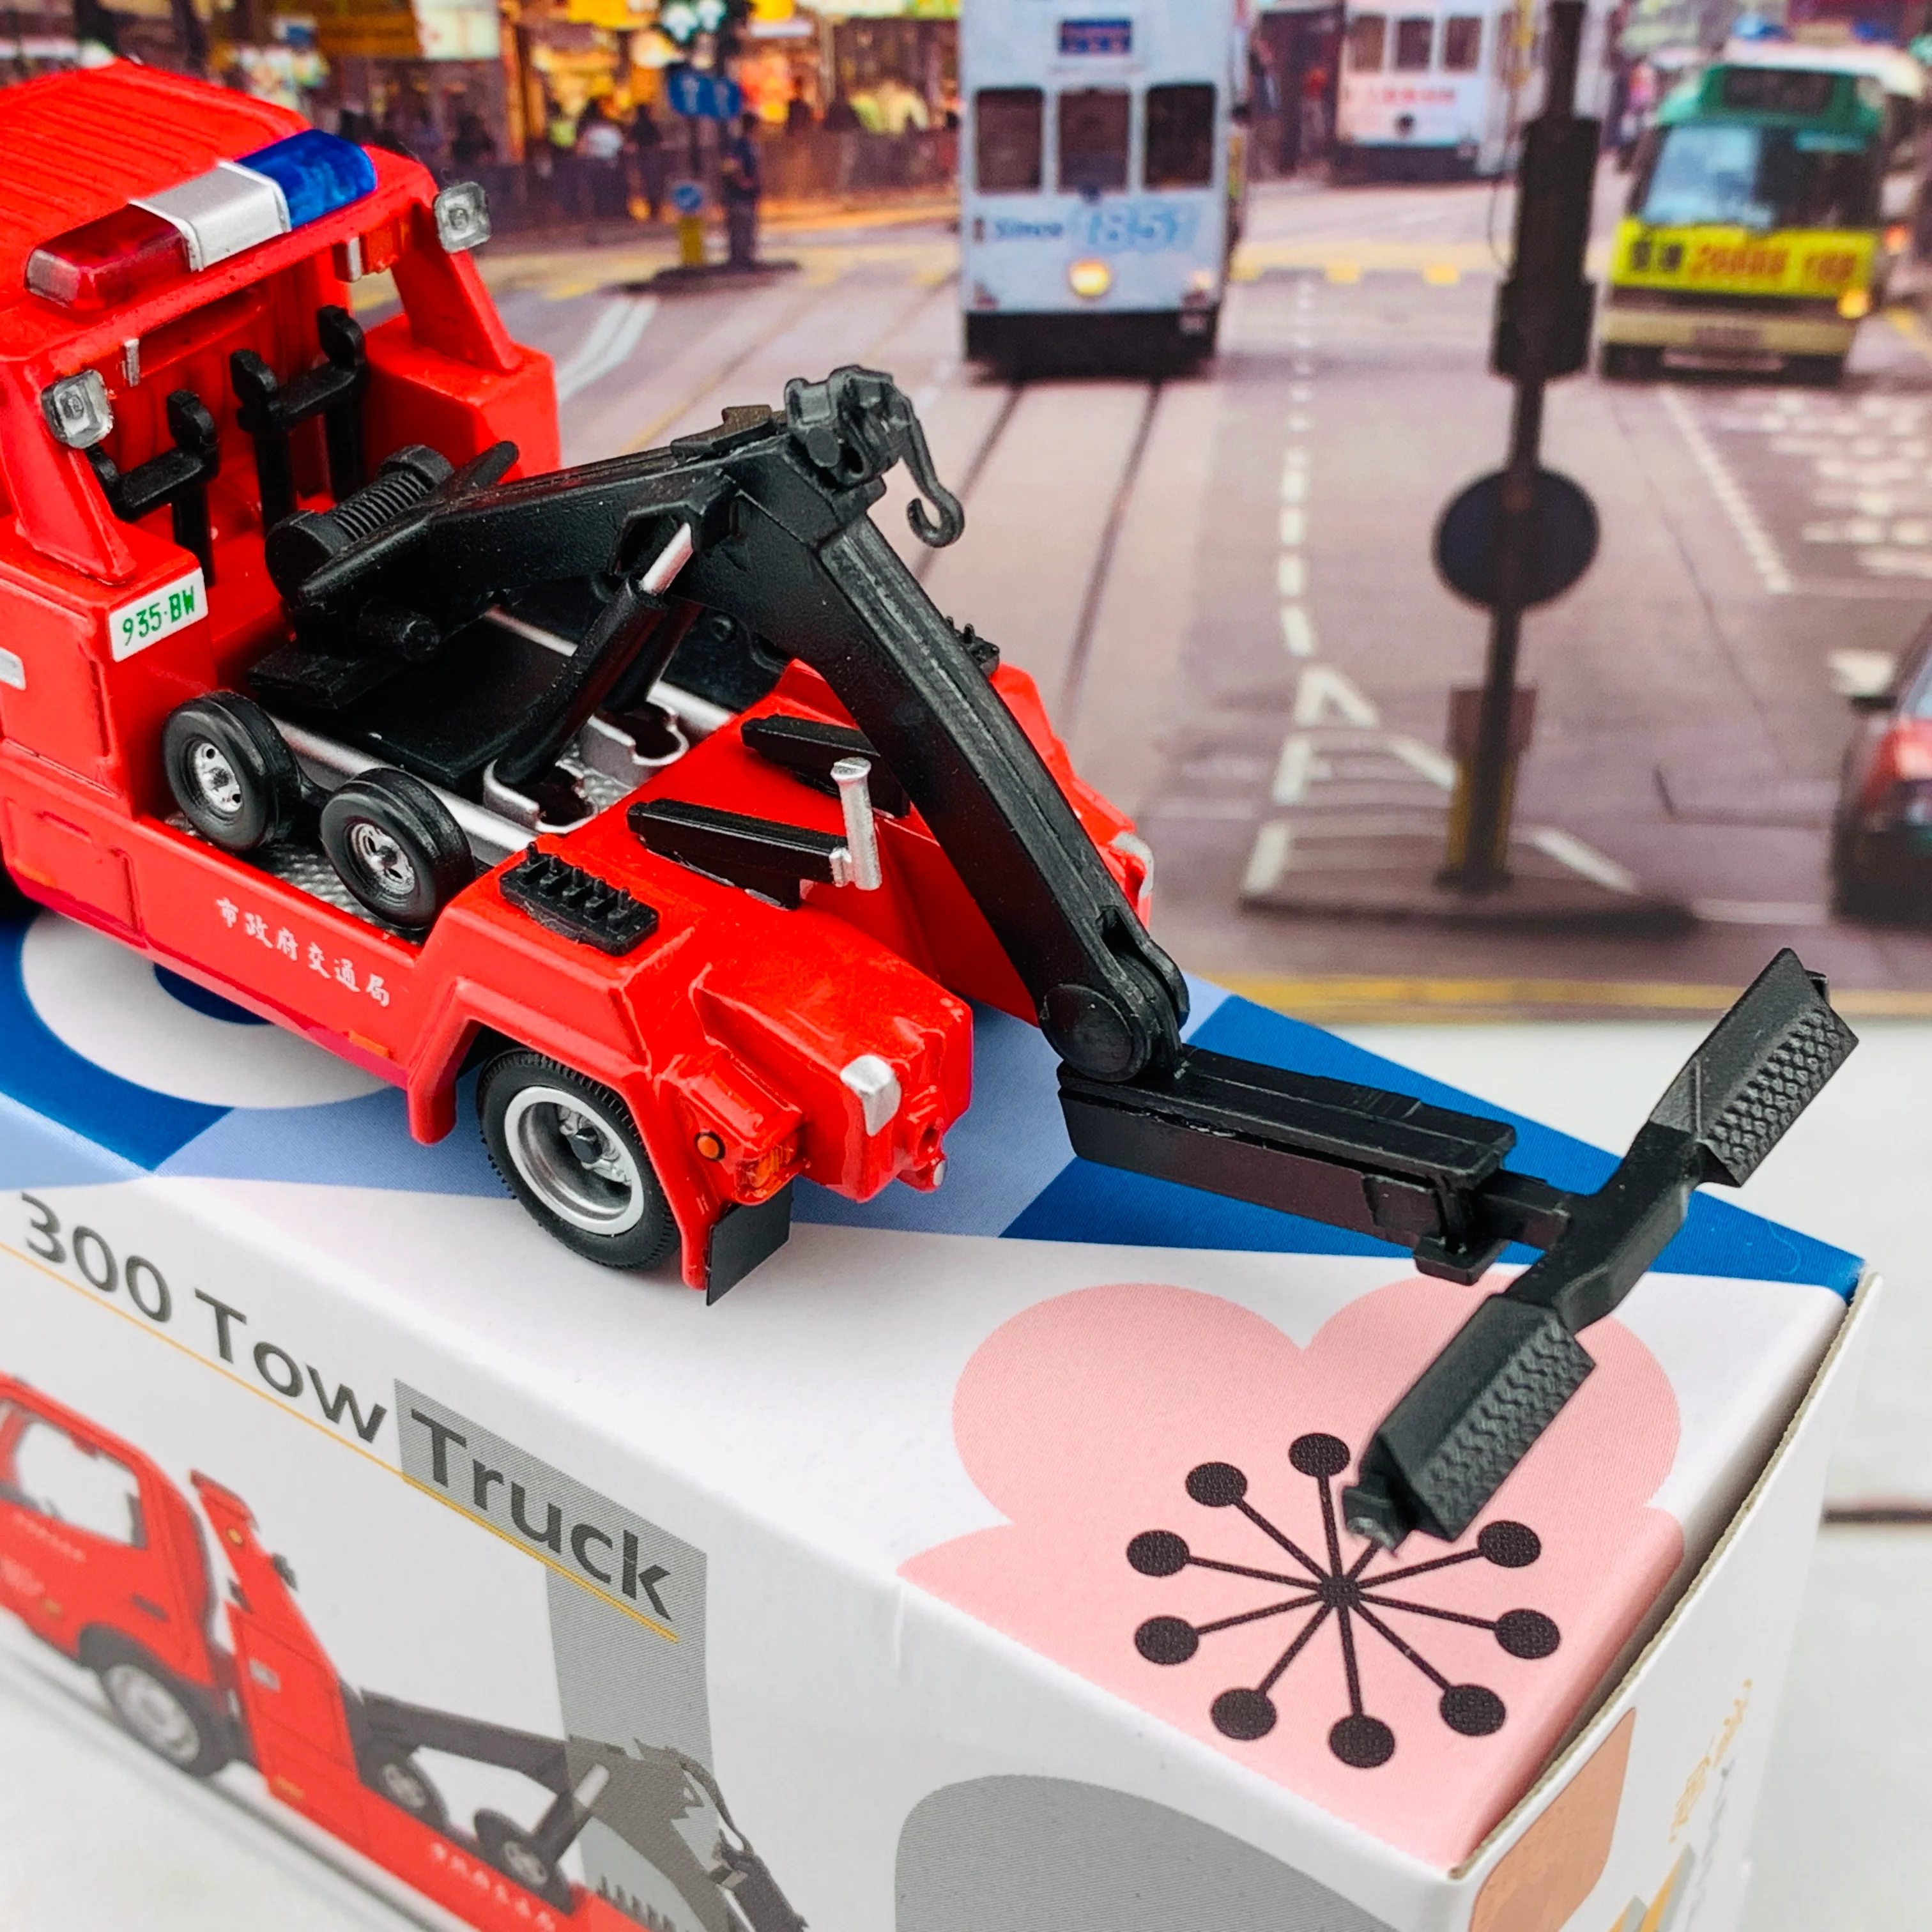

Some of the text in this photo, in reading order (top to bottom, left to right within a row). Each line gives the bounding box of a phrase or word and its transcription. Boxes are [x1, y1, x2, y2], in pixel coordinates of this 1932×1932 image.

[216, 897, 390, 1008] 市政府交通局
[21, 1192, 672, 1621] 300 Tow Truck
